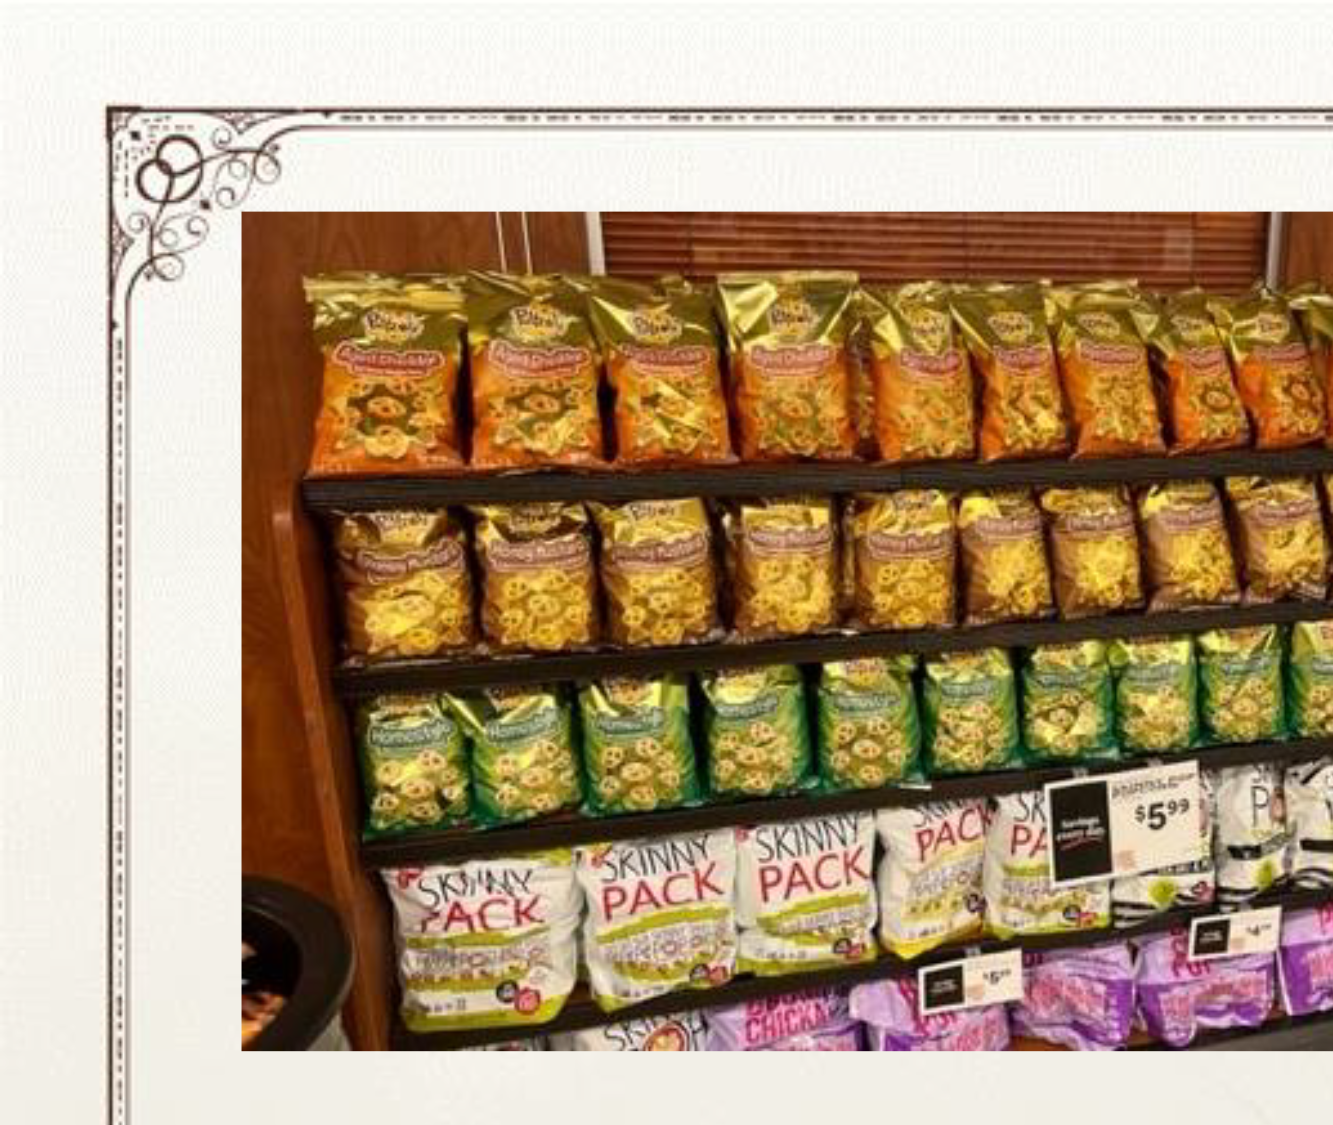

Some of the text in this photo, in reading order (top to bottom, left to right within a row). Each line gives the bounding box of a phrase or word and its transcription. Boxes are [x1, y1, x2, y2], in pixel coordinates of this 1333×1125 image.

[598, 832, 710, 884] SKINNY
[757, 813, 862, 863] SKINNY
[600, 860, 725, 922] PACK
[759, 845, 871, 904] PACK
